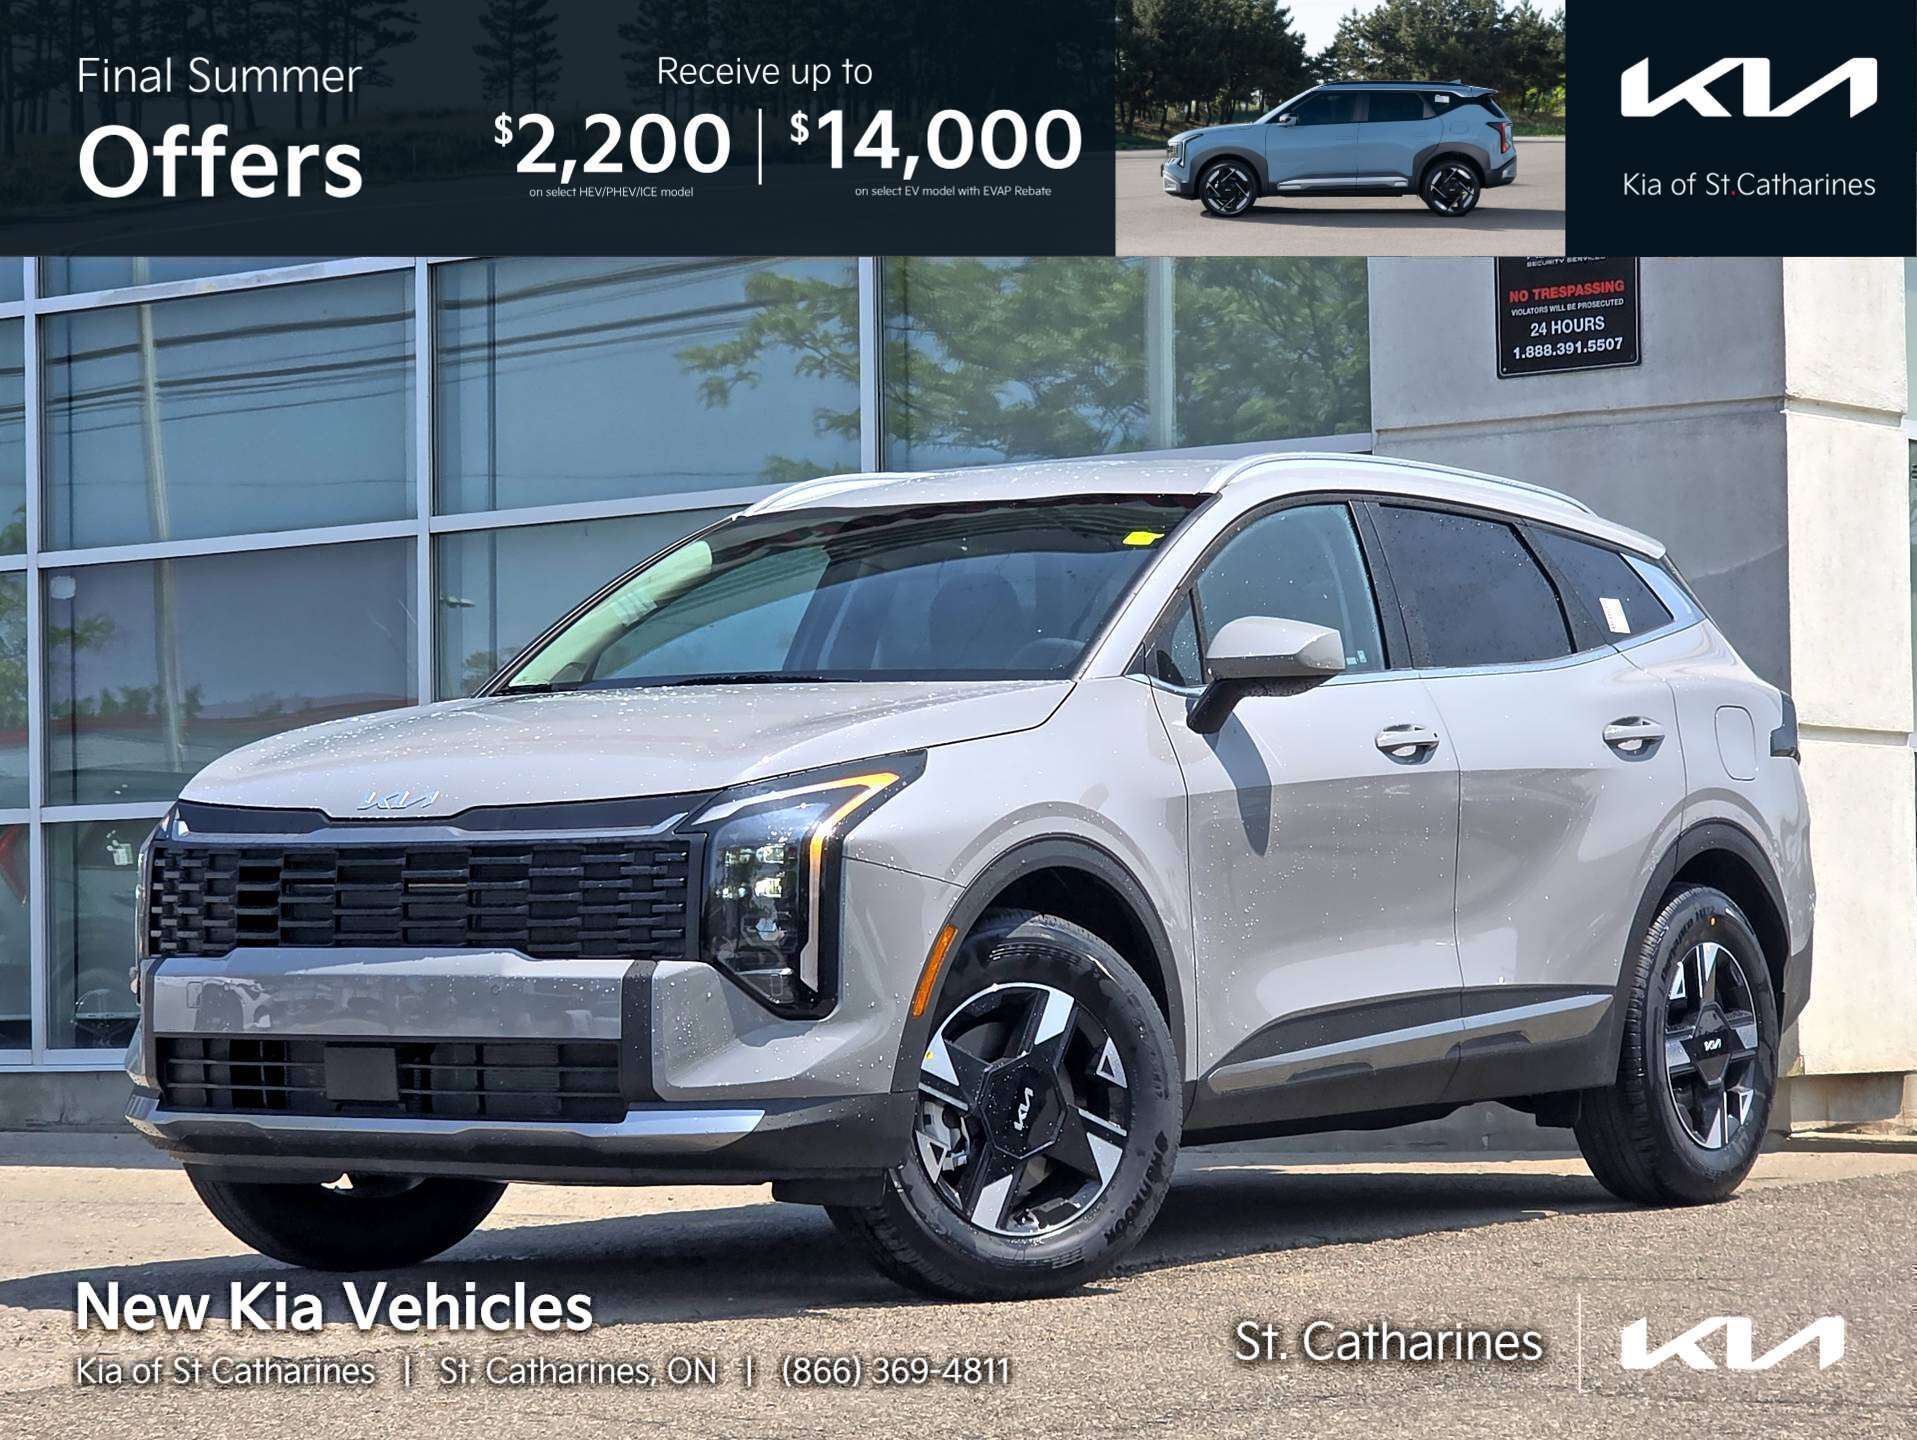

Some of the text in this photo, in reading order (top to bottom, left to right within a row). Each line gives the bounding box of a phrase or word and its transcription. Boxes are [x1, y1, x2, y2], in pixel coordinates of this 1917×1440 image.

[1526, 258, 1565, 268] SECURITY
[1508, 279, 1625, 303] NO TRESPASSING
[1510, 297, 1625, 317] VIOLATORS WILL BE PROSECUTED
[1530, 315, 1606, 338] 24 HOURS
[1512, 336, 1624, 360] 1.888.391.5507
[356, 790, 440, 811] KIA
